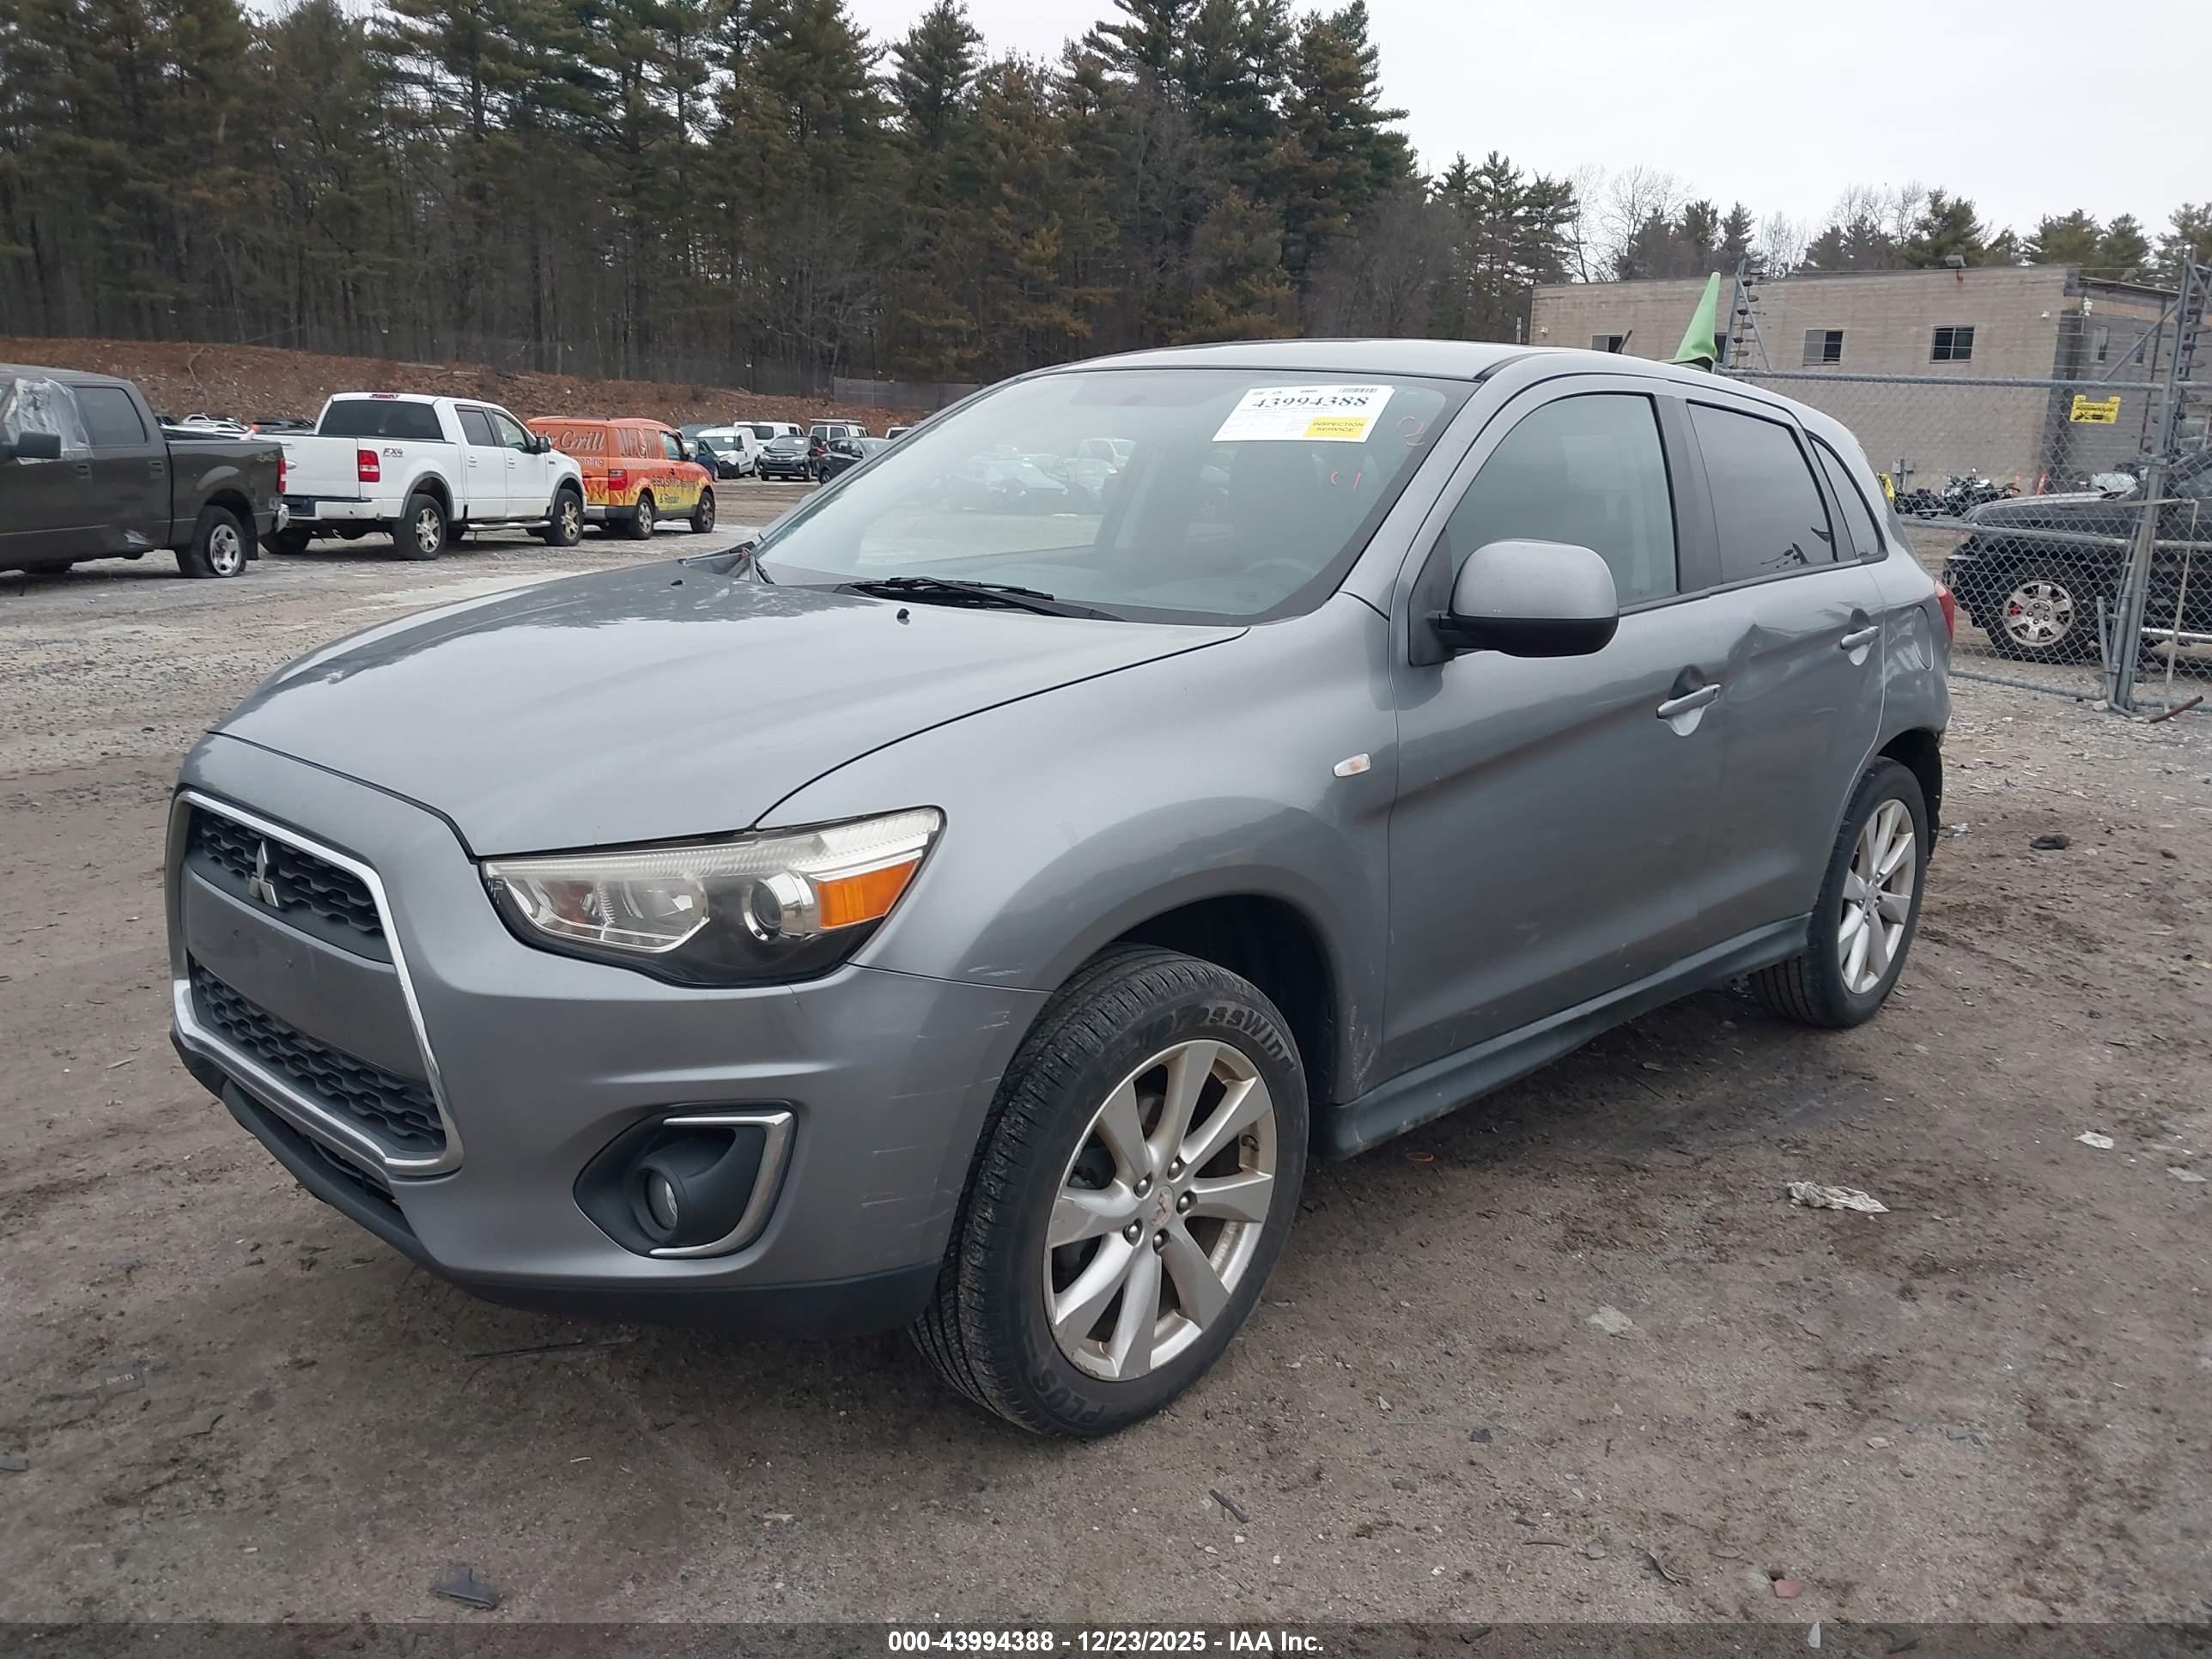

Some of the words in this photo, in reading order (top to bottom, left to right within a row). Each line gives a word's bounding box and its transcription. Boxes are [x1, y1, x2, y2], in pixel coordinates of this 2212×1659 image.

[1251, 396, 1370, 408] 43994388
[560, 429, 605, 451] Grill
[383, 447, 404, 456] FX4
